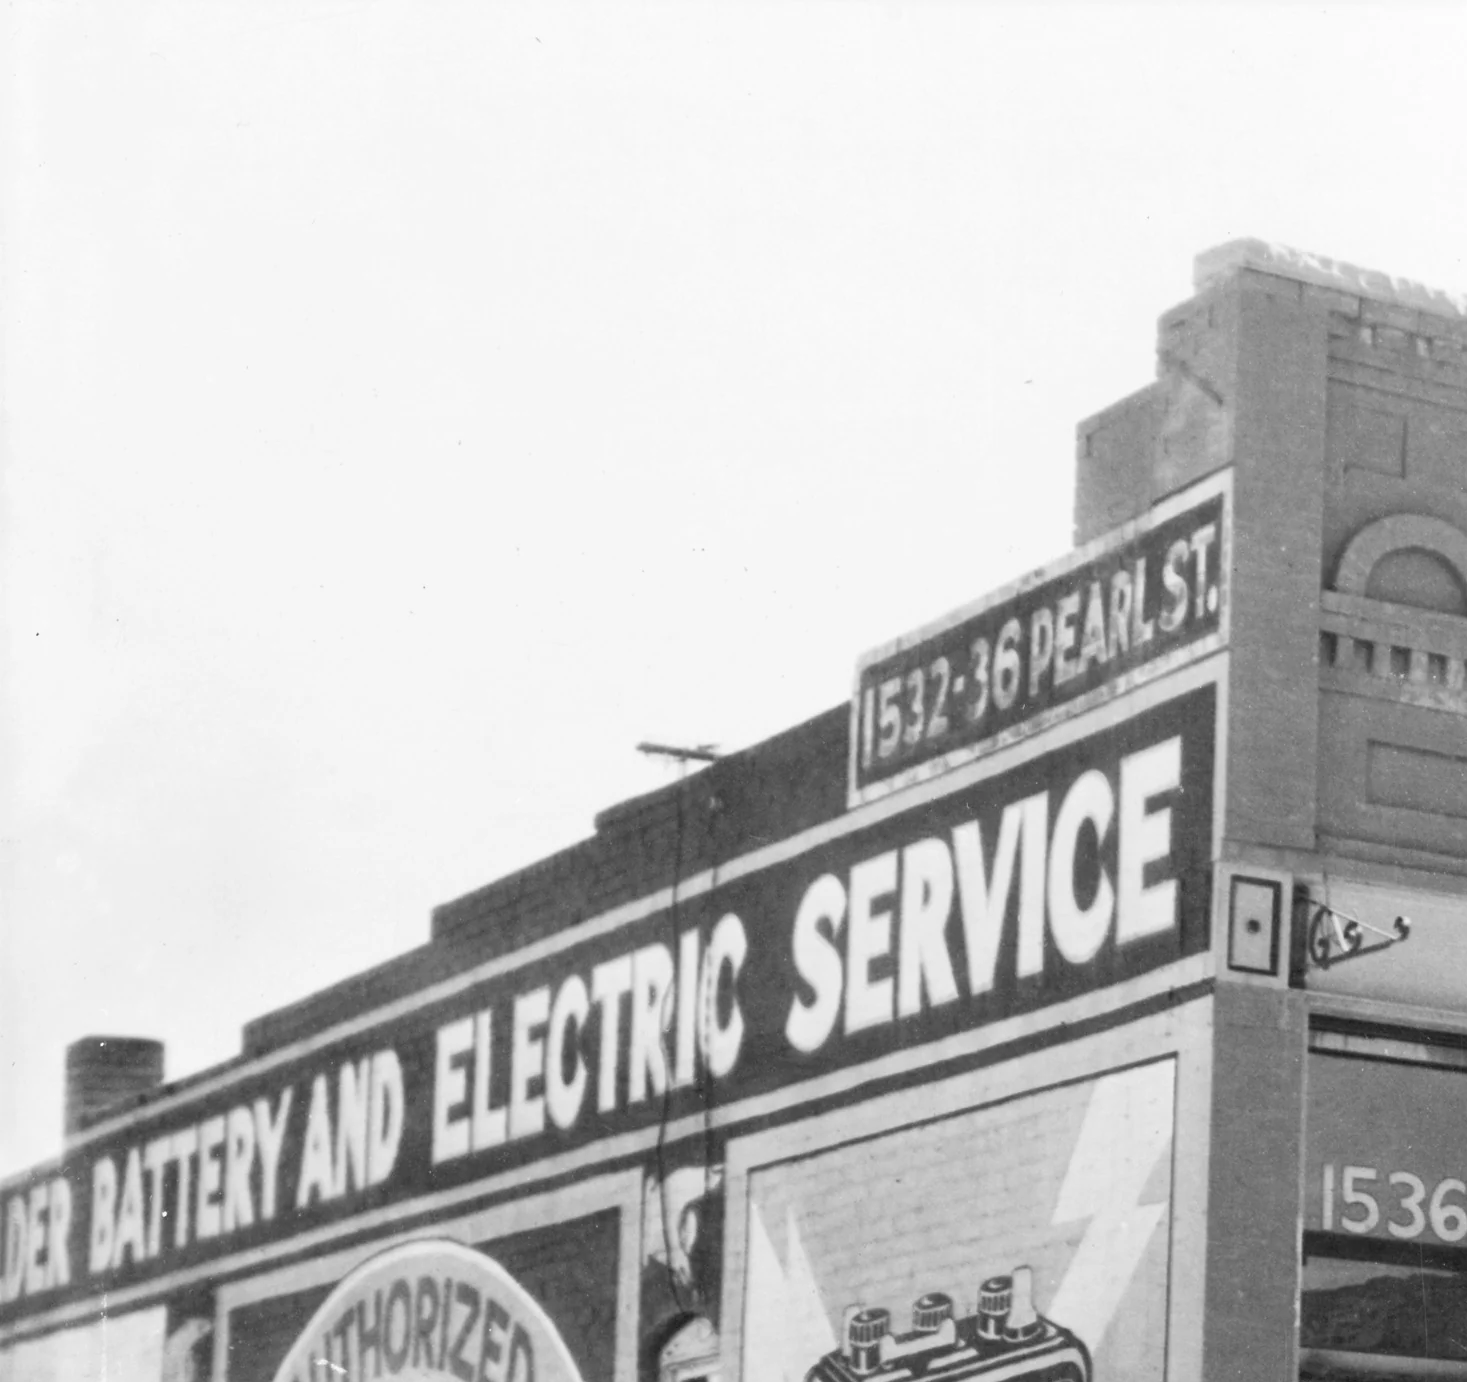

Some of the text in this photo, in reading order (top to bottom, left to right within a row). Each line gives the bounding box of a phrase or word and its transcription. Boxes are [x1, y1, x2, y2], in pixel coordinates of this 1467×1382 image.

[861, 523, 1219, 770] 1532-36 PEARL ST.
[0, 734, 1182, 1303] DER BATTERY AND ELECTRIC SERVICE
